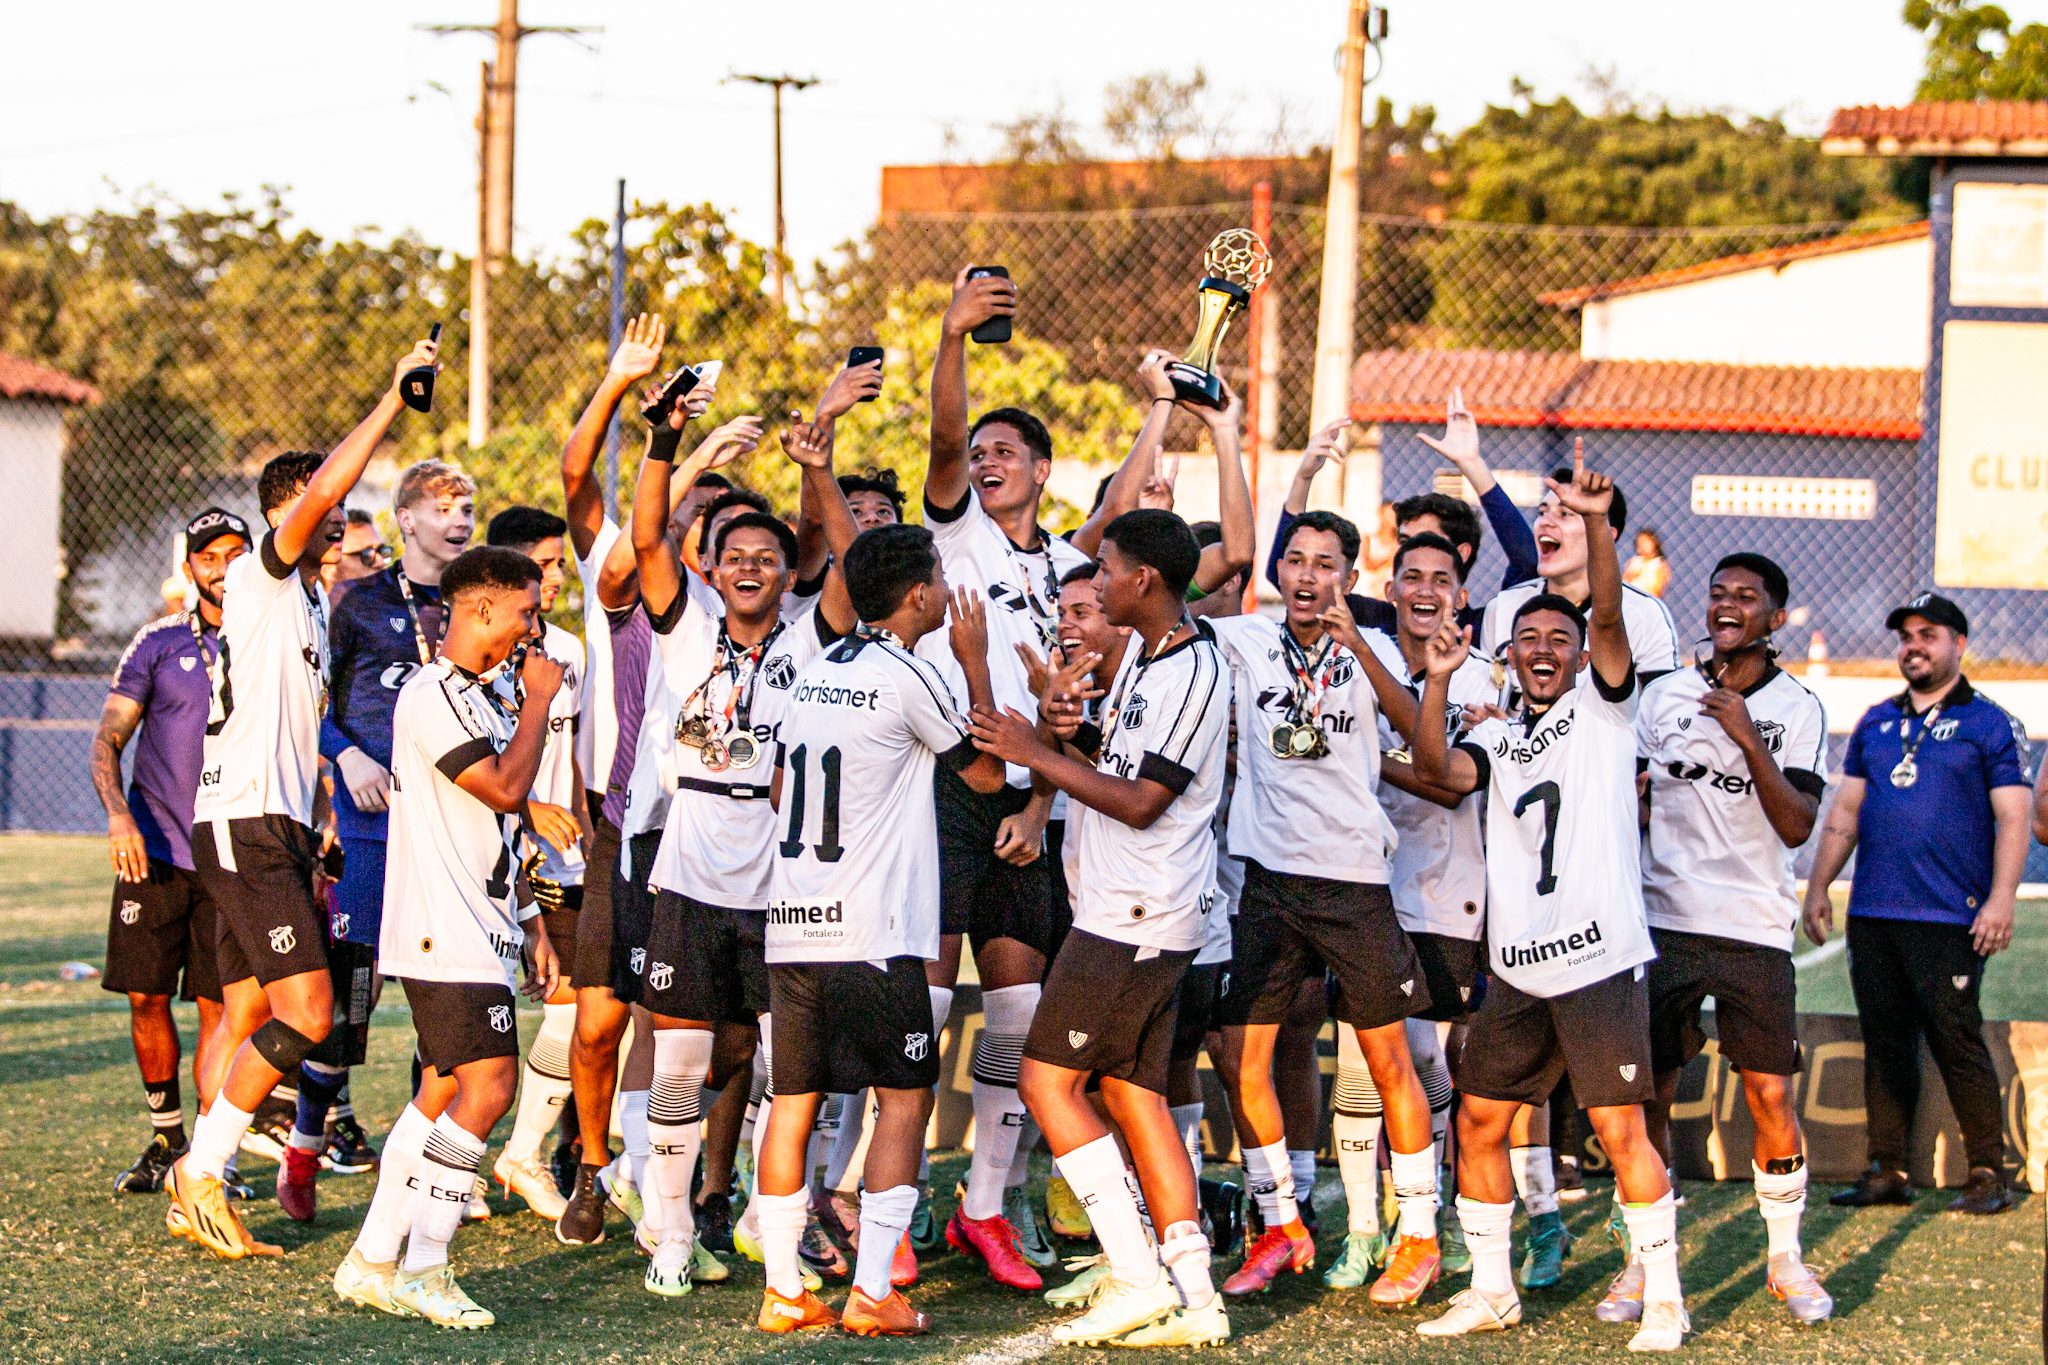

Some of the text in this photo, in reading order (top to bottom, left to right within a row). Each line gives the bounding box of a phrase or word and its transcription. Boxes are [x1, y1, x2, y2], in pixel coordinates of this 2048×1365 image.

[1969, 452, 2048, 492] CLU
[199, 765, 222, 787] ed
[779, 742, 846, 863] 11
[1513, 779, 1561, 896] 7
[803, 929, 844, 938] Fortaleza
[1501, 920, 1602, 968] Unimed
[1567, 947, 1606, 966] Fortaleza
[1340, 1138, 1374, 1152] CSC
[430, 1185, 472, 1203] CSC
